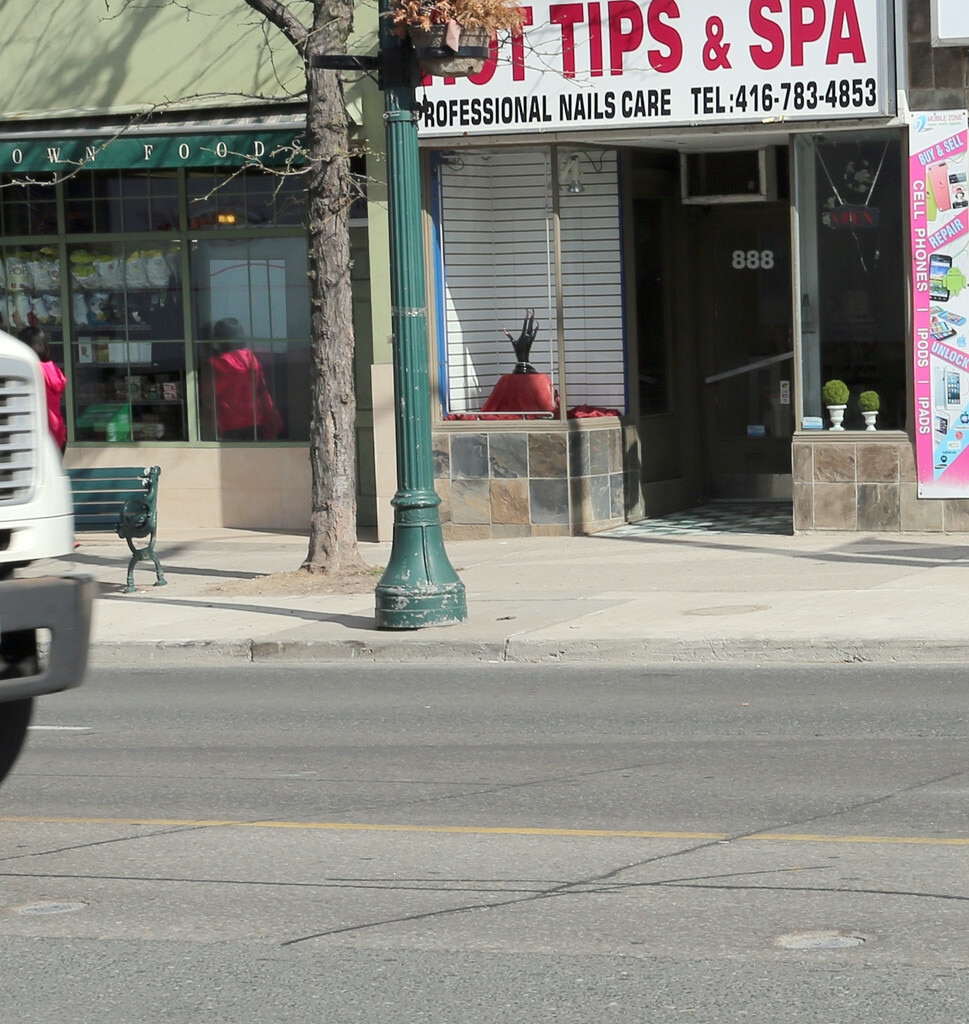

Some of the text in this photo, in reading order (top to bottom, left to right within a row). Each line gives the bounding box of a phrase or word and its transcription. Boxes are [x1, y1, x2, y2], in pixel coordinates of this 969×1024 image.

[702, 15, 732, 72] &
[559, 89, 616, 122] NAILS
[622, 88, 672, 118] CARE
[918, 134, 964, 166] BUY & SELL
[913, 180, 925, 220] CELL
[929, 218, 964, 249] REPAIR
[732, 249, 774, 269] 888
[914, 228, 928, 292] PHONES
[917, 328, 929, 367] IPODS
[918, 397, 931, 434] IPADS
